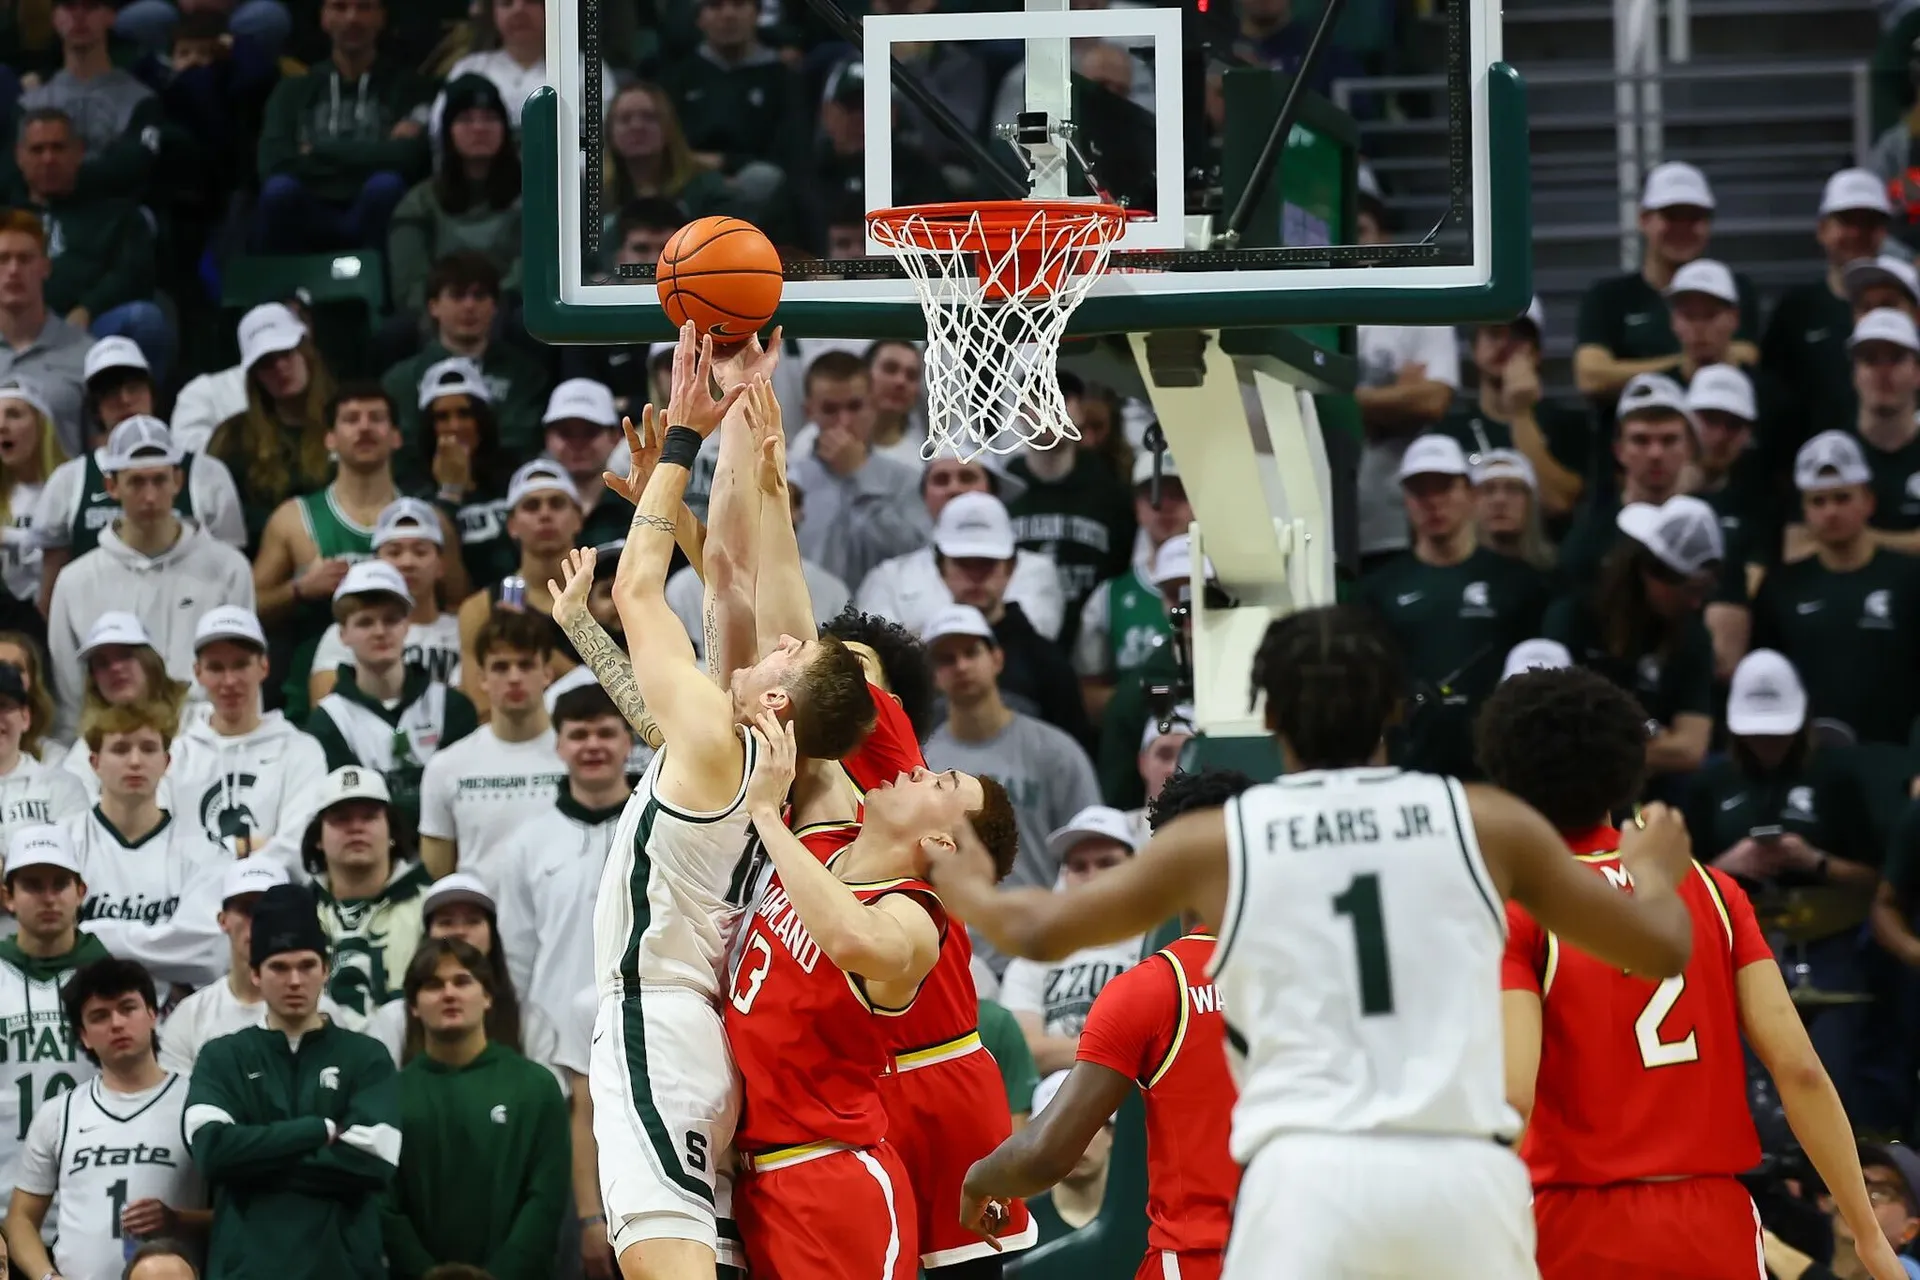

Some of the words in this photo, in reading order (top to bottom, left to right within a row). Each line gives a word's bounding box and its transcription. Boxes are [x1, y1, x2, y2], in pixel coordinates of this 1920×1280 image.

[1266, 808, 1380, 854] FEARS
[1393, 804, 1447, 840] JR.
[1331, 872, 1394, 1018] 1
[1634, 970, 1699, 1069] 2
[68, 1142, 177, 1176] State
[685, 1130, 708, 1173] S
[106, 1179, 128, 1239] 1
